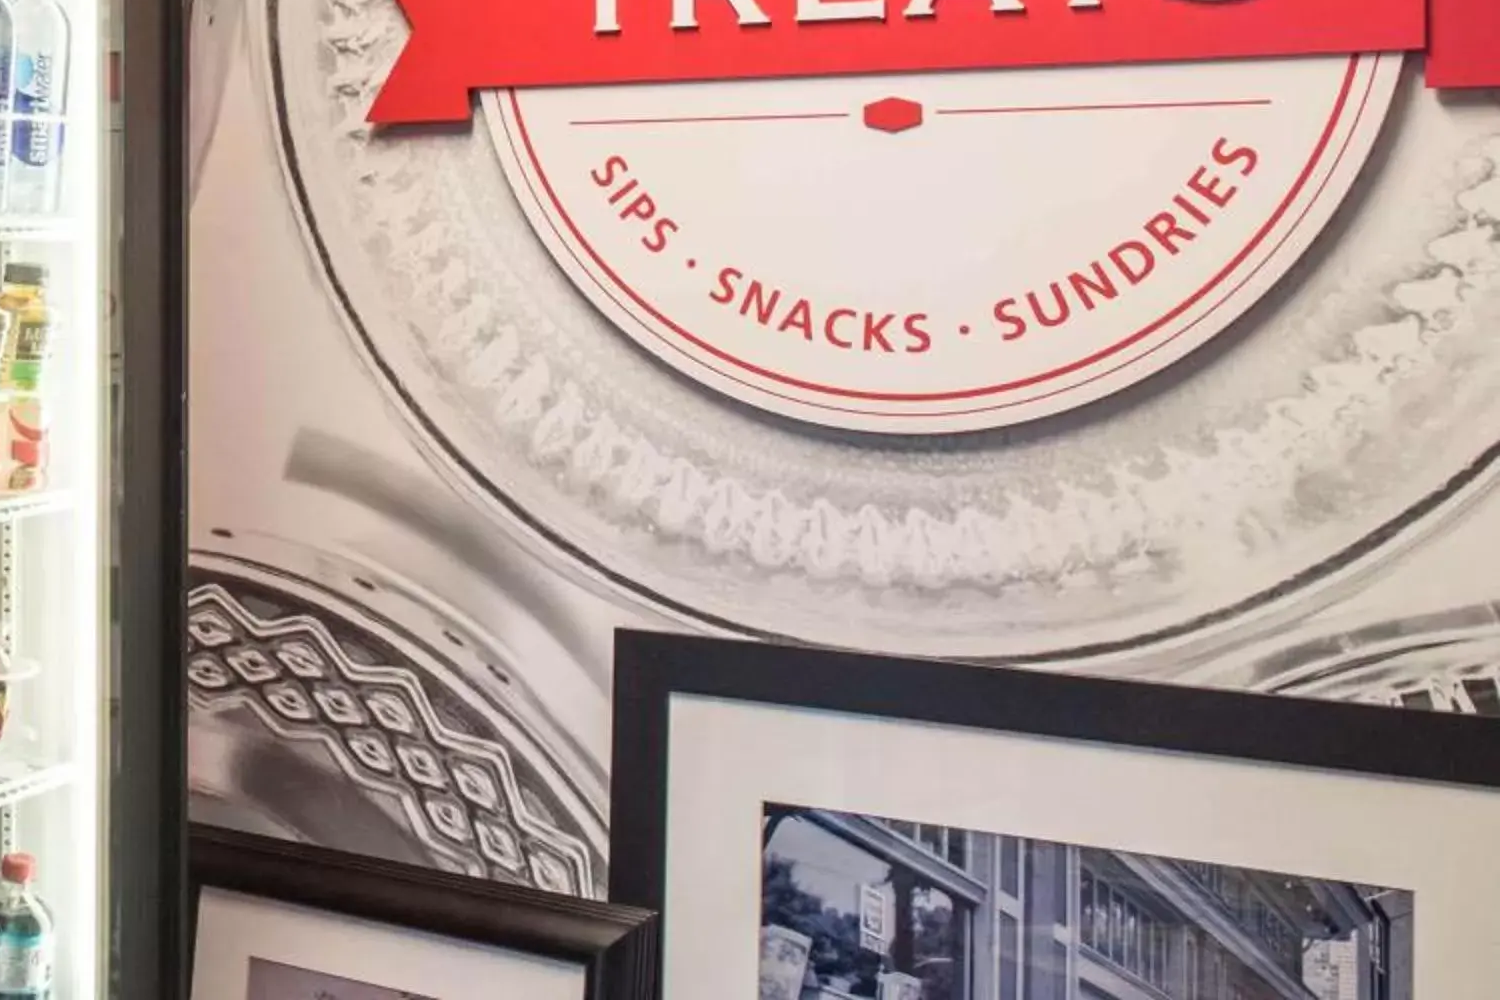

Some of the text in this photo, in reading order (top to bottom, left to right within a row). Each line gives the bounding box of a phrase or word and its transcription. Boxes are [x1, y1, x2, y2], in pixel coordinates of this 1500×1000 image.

[590, 136, 1261, 357] SIPS SNACKS SUNDRIES
